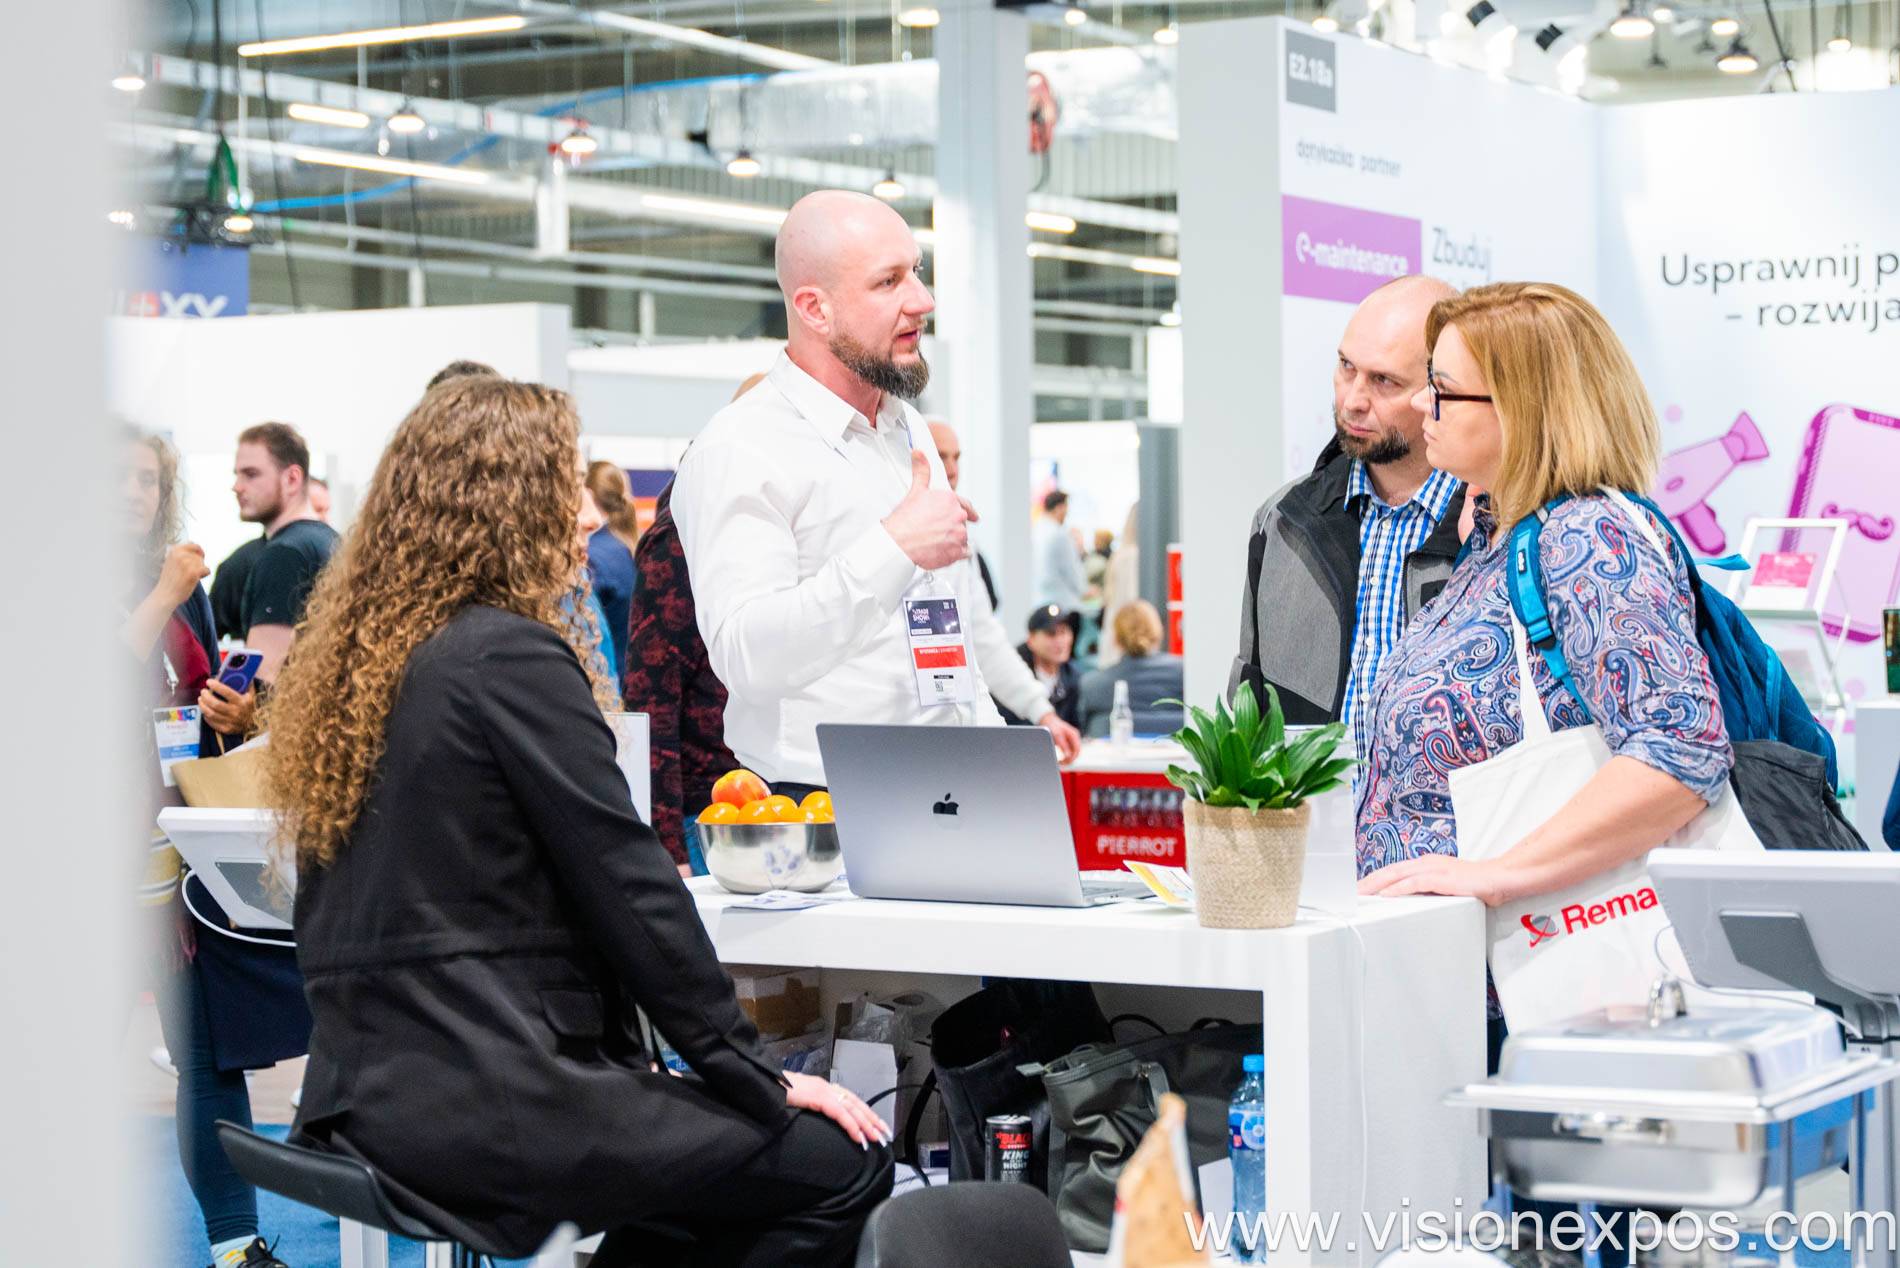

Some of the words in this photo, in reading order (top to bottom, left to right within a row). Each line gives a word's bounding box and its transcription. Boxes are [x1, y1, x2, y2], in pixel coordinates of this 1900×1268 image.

[1432, 226, 1490, 283] Zbuduj
[1661, 243, 1859, 294] Usprawnij
[1758, 288, 1900, 333] rozwija
[1097, 835, 1177, 857] PIERROT
[1561, 887, 1658, 935] Rema
